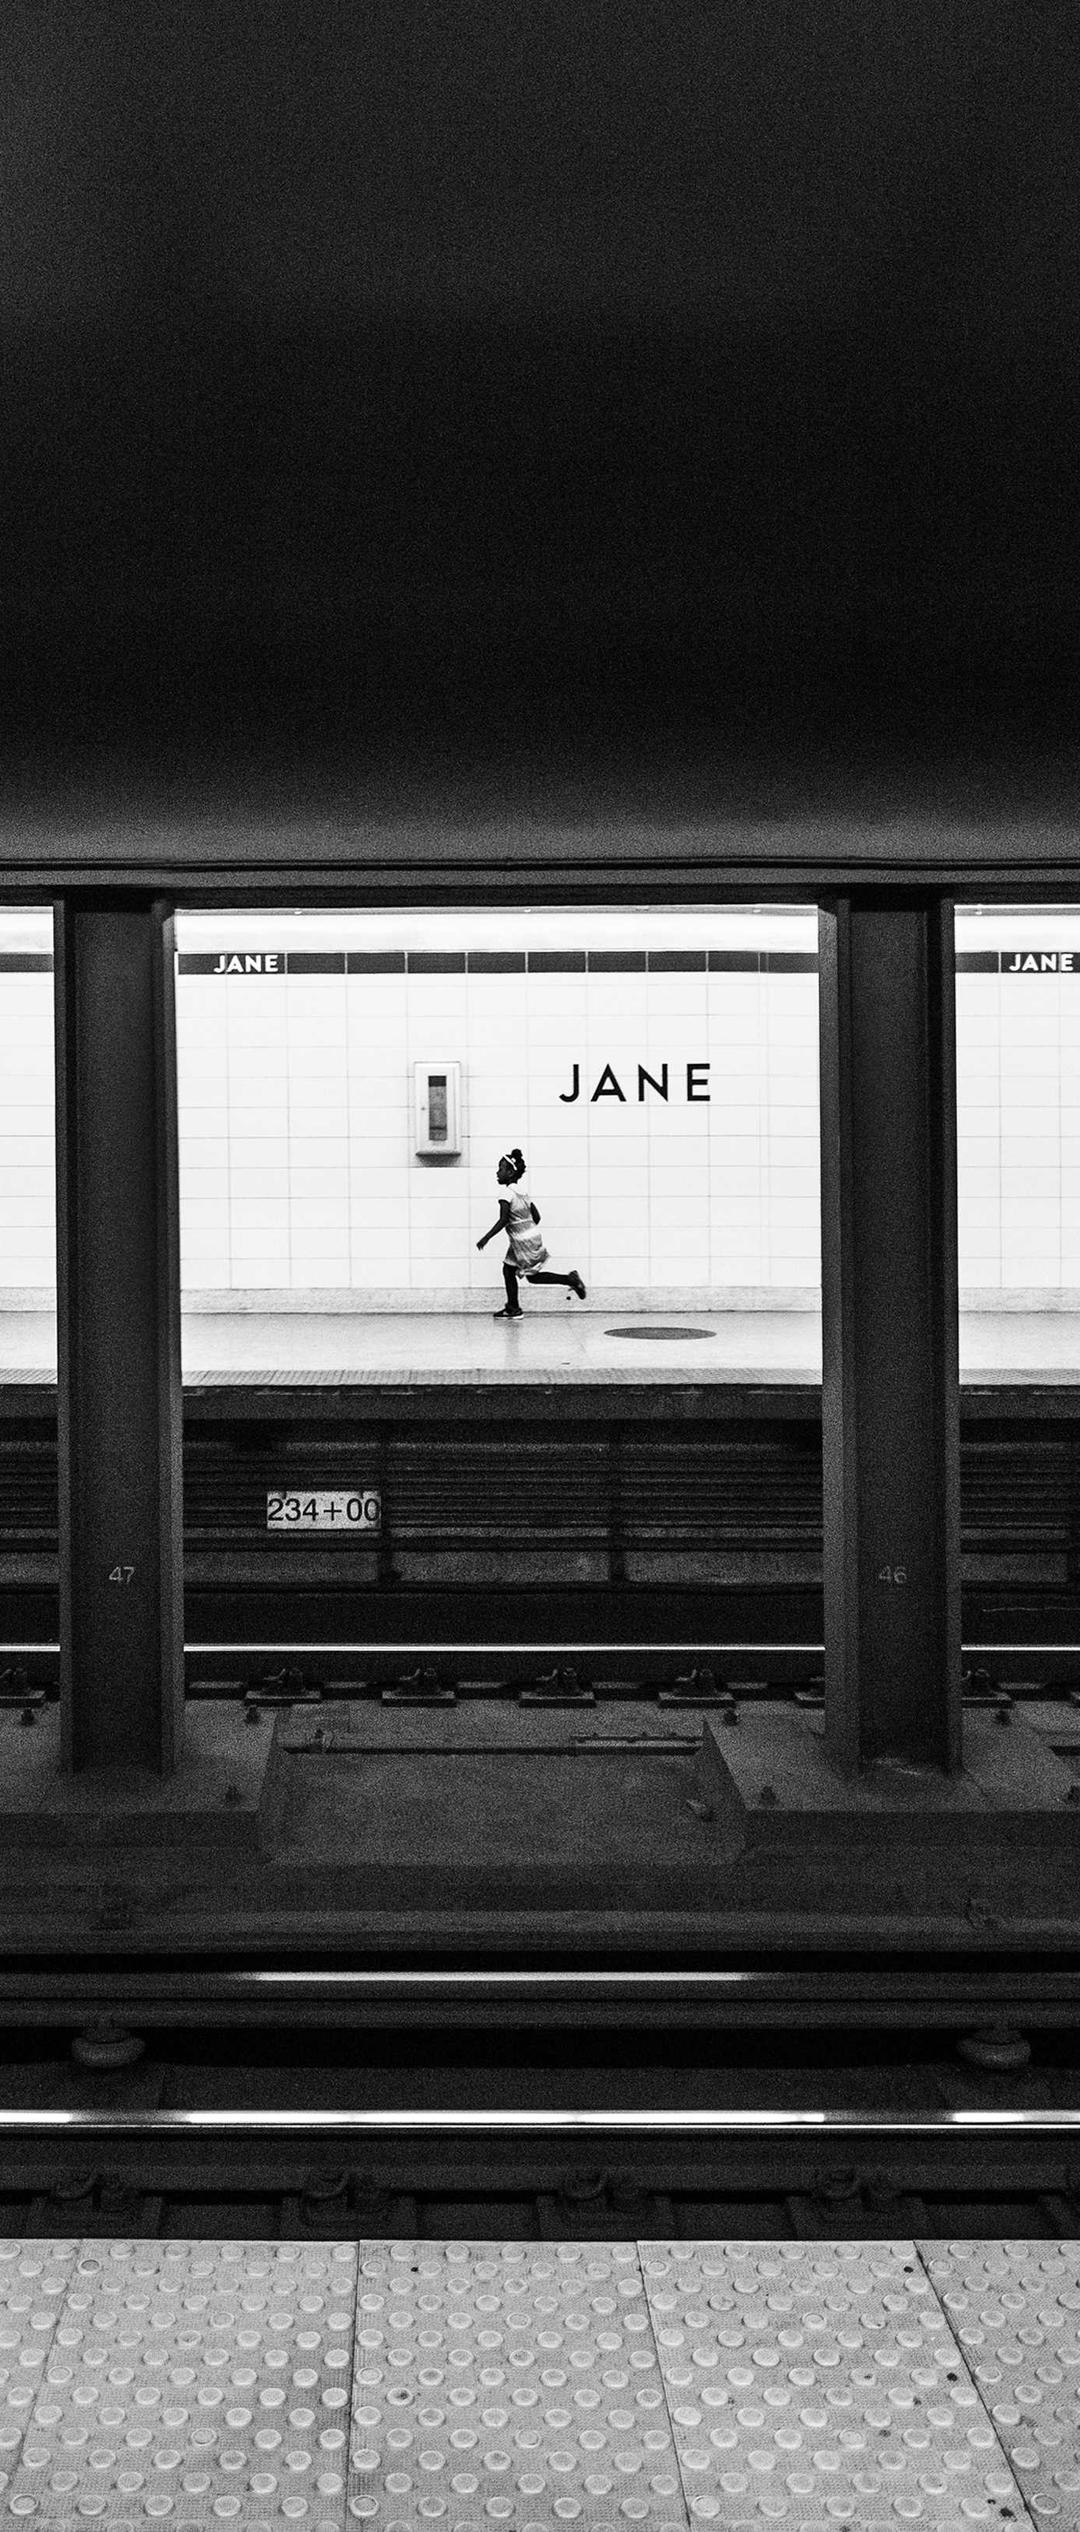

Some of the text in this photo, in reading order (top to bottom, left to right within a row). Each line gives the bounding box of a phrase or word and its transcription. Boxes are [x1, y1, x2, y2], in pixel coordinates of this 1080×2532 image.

[213, 954, 279, 973] JANE
[1008, 953, 1074, 971] JANE
[559, 1063, 711, 1103] JANE
[267, 1498, 381, 1522] 234+00
[108, 1566, 135, 1584] 47
[879, 1565, 907, 1584] 46
